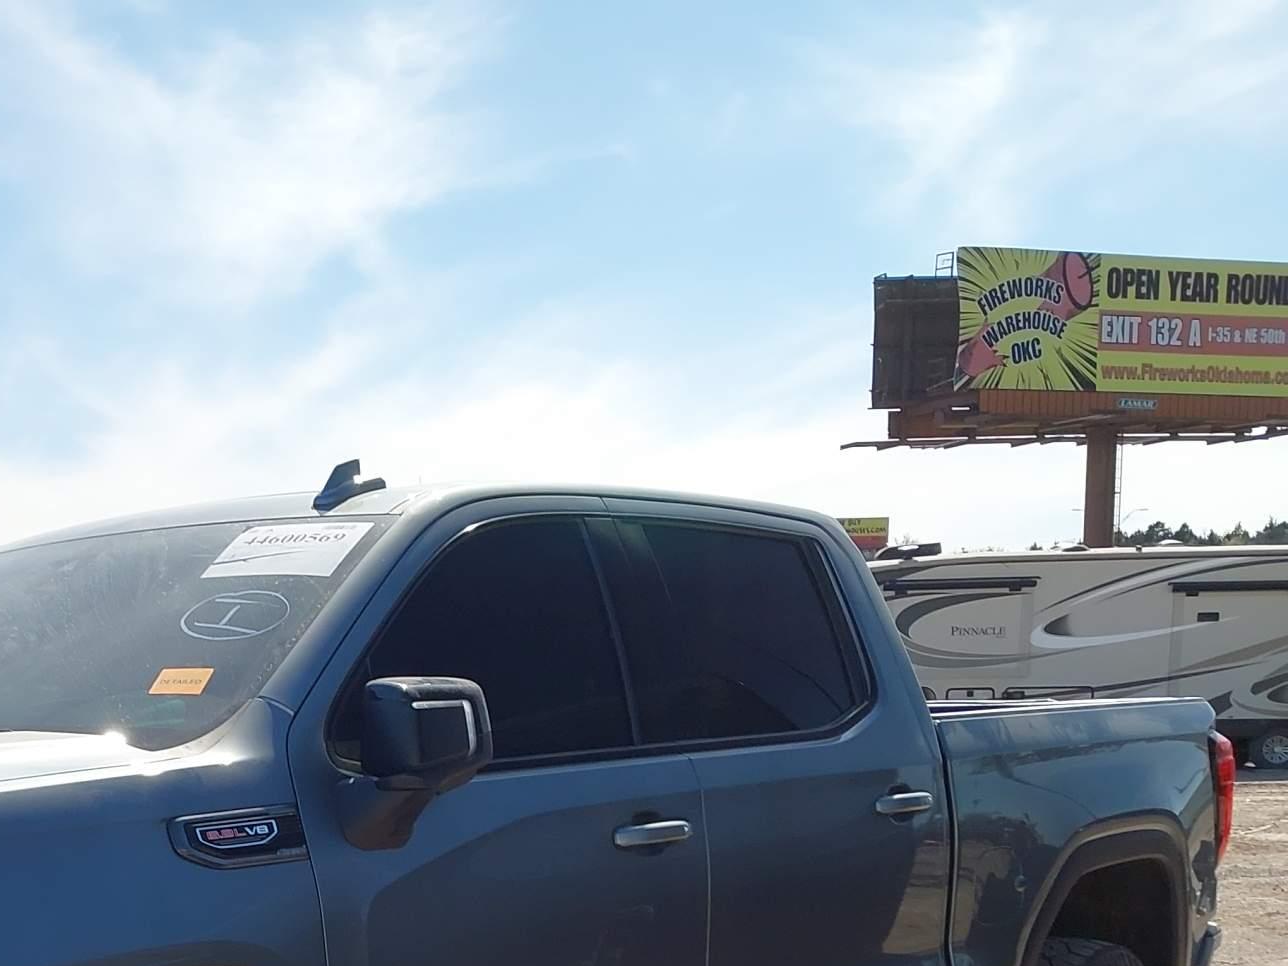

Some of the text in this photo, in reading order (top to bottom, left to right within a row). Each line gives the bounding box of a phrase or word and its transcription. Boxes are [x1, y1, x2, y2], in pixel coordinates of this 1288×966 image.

[976, 276, 1064, 316] FIREWORKS
[1107, 267, 1160, 301] OPEN
[1168, 271, 1219, 303] YEAR
[982, 311, 1067, 348] WAREHOUSE
[1101, 315, 1141, 344] EXIT
[1148, 317, 1183, 346] 132
[1188, 319, 1202, 347] A
[1011, 337, 1042, 364] OKC
[243, 531, 346, 545] 44600569
